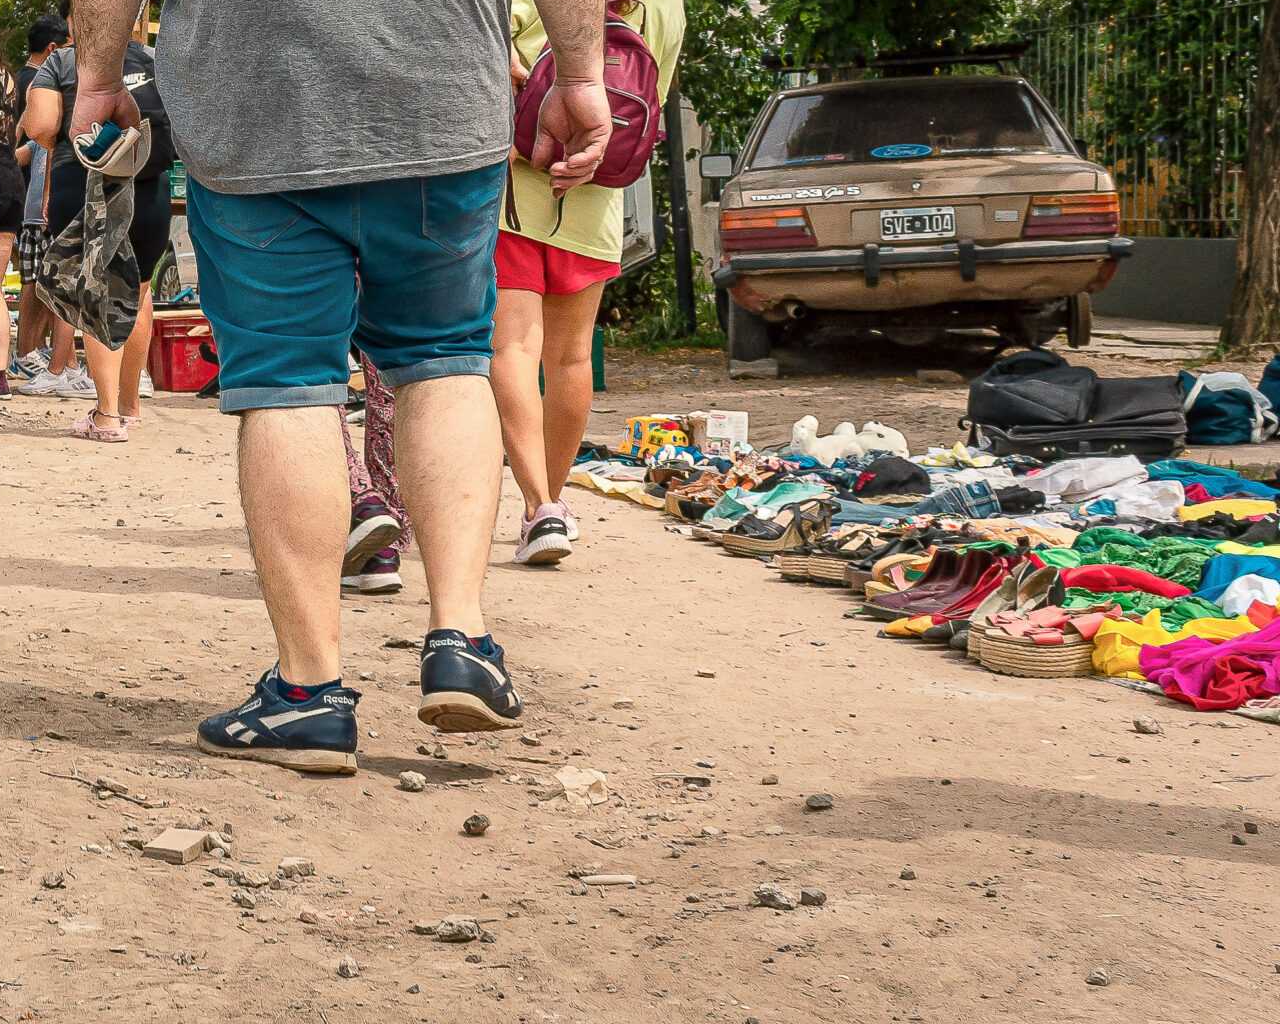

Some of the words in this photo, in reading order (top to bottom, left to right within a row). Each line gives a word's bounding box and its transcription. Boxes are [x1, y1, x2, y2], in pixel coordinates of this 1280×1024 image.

[122, 72, 146, 85] NIKE
[883, 146, 920, 156] Ford
[884, 217, 913, 234] SVE
[922, 215, 952, 232] 104
[429, 637, 467, 649] Reebok
